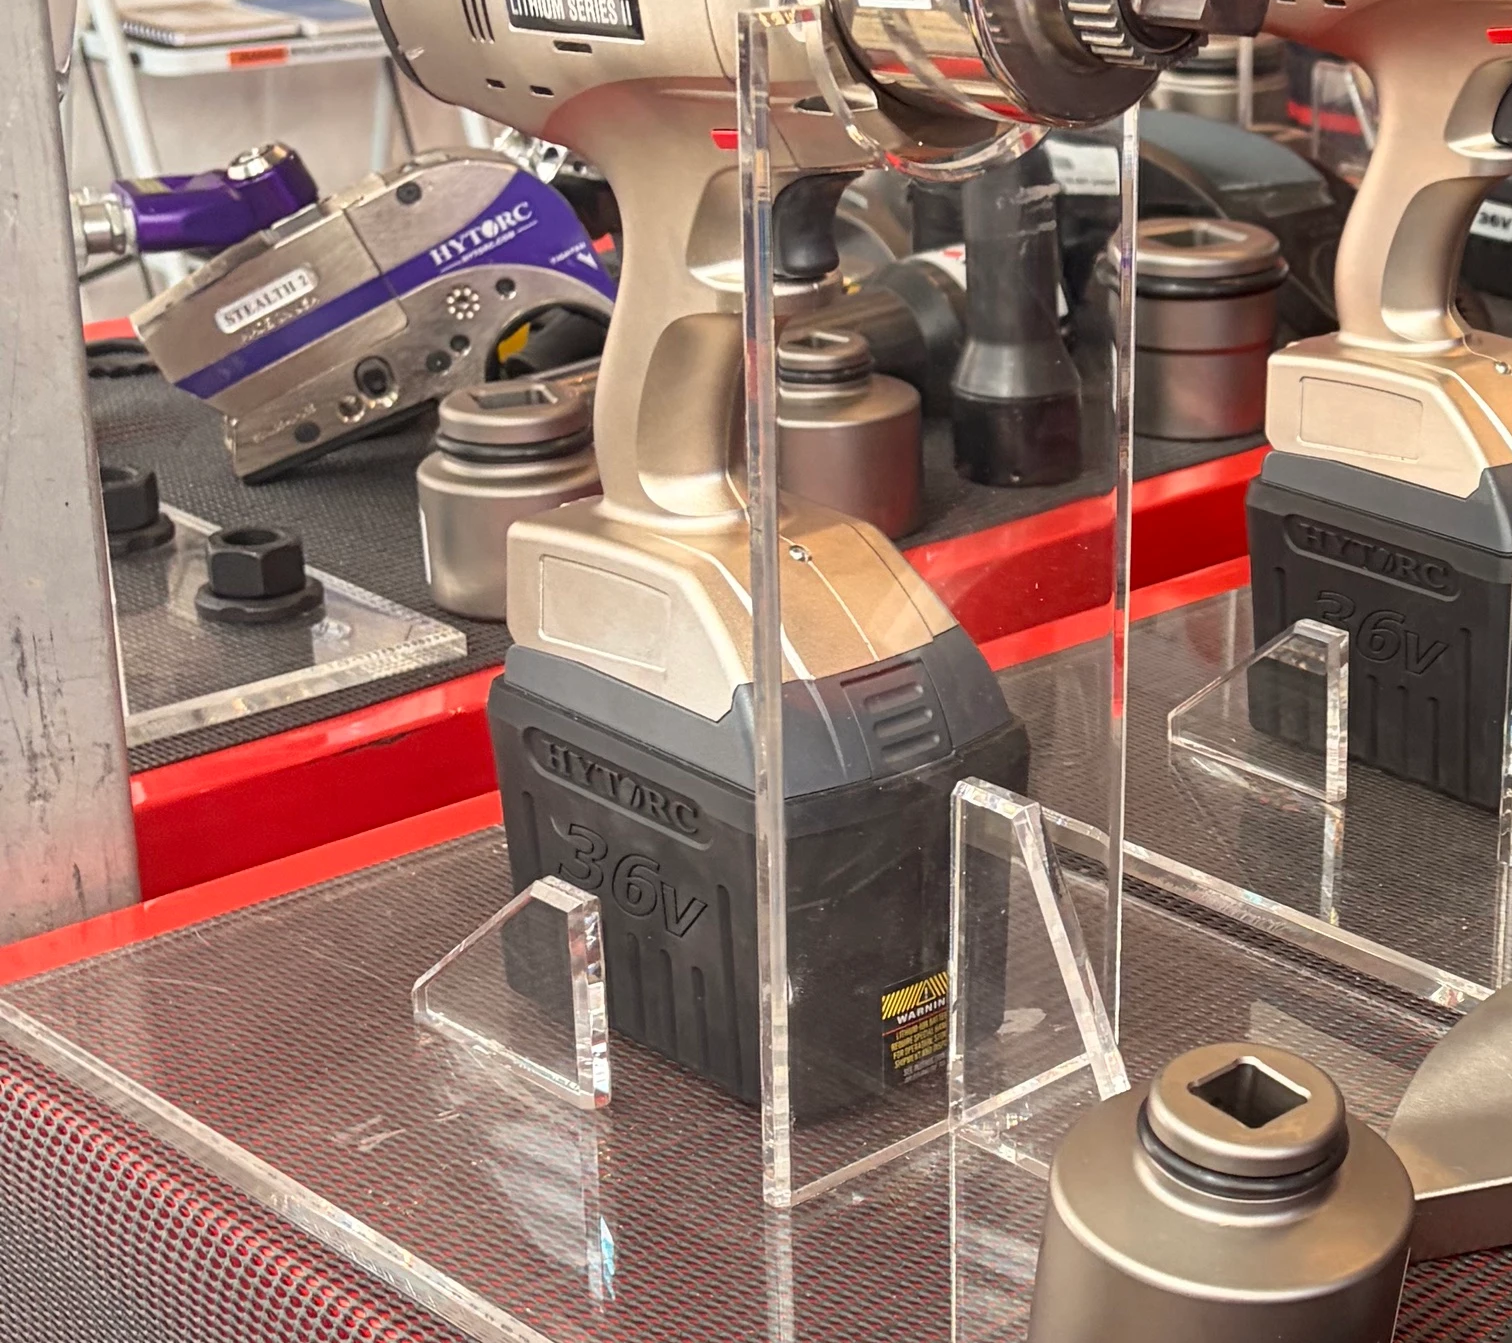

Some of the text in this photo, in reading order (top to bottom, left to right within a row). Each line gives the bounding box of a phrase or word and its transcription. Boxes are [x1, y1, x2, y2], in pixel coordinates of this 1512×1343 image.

[620, 0, 633, 26] II
[429, 201, 533, 266] HYTORC
[224, 279, 297, 327] STEALTH
[298, 274, 308, 287] 2
[543, 740, 698, 834] HYTORC
[897, 997, 946, 1025] WARNIN
